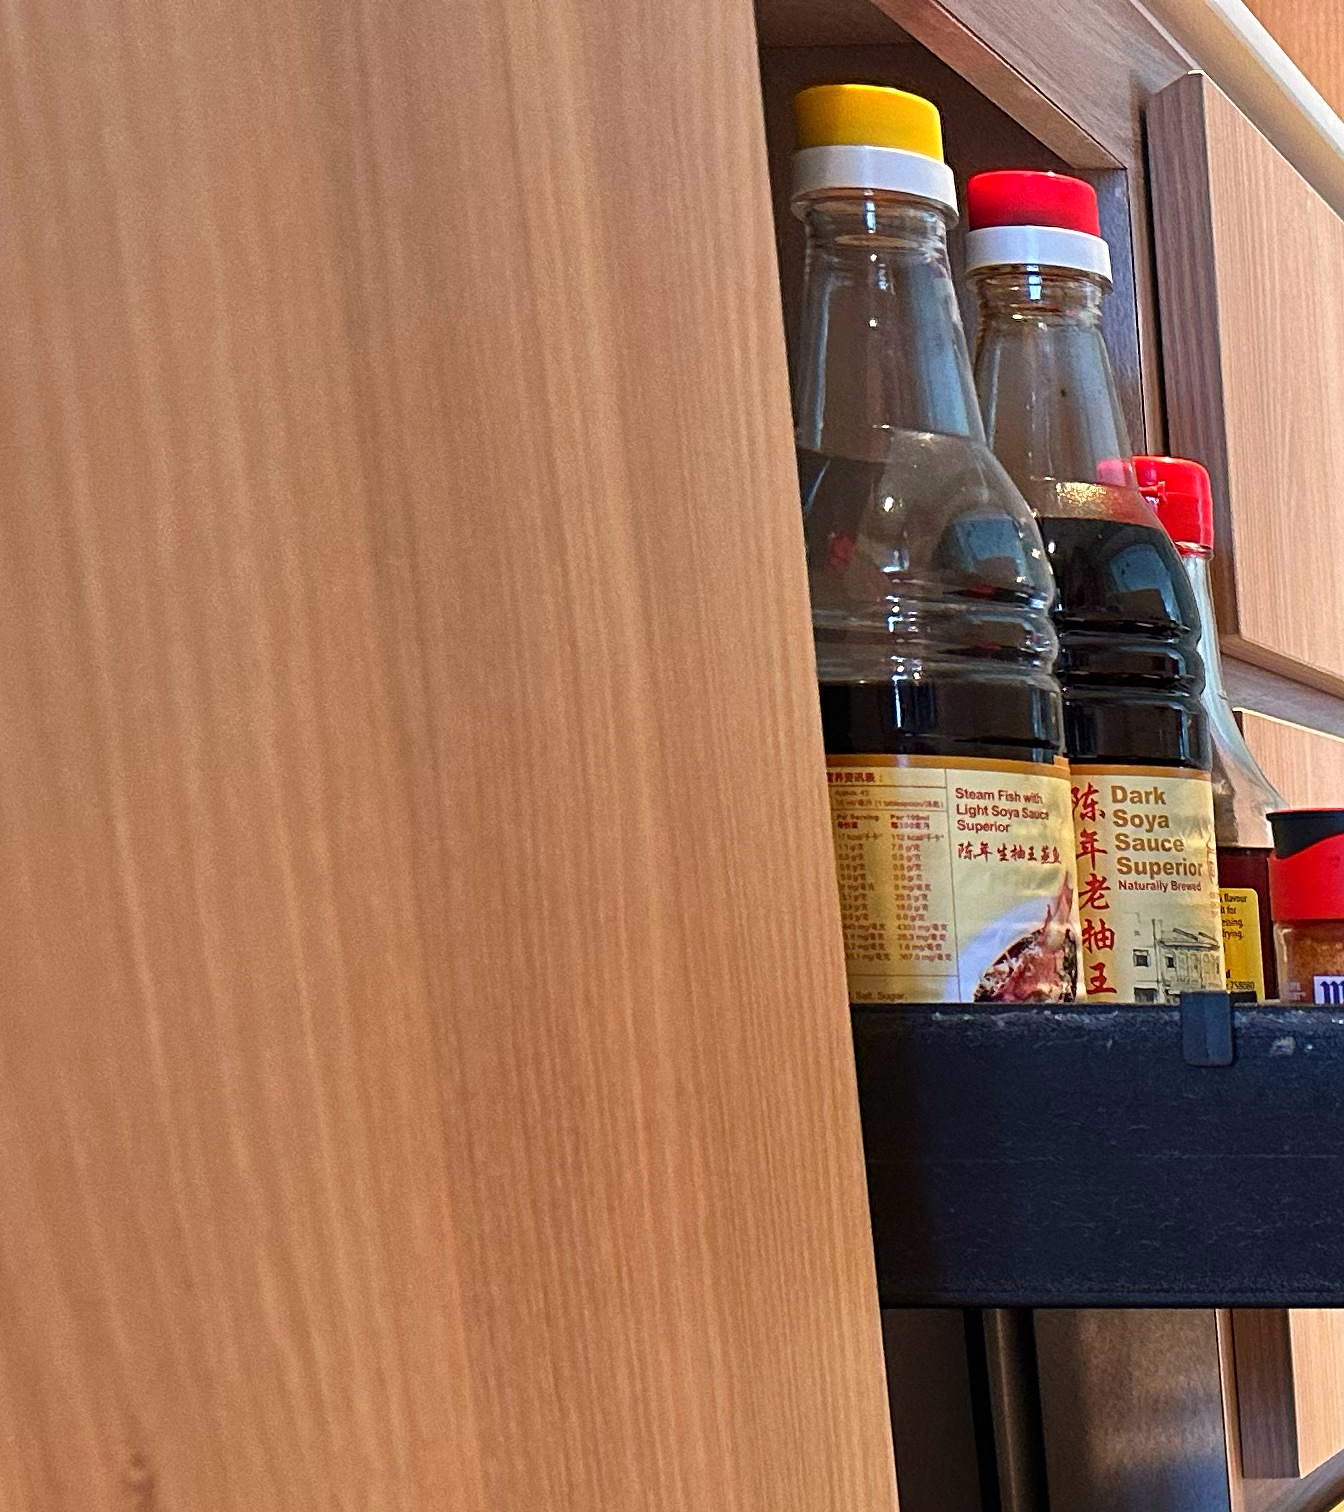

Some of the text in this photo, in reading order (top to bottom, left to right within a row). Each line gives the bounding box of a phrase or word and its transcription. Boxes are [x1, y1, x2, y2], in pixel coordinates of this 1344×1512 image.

[955, 787, 1044, 804] Steam Fish with
[1110, 785, 1167, 806] Dark
[956, 804, 989, 818] Light
[991, 805, 1020, 820] Soya
[1021, 807, 1050, 820] Sauce
[1112, 809, 1170, 832] Soya
[957, 820, 1011, 834] Superior
[1114, 833, 1185, 852] Sauce
[1116, 857, 1203, 880] Superior
[1118, 880, 1202, 893] Naturally Brewed
